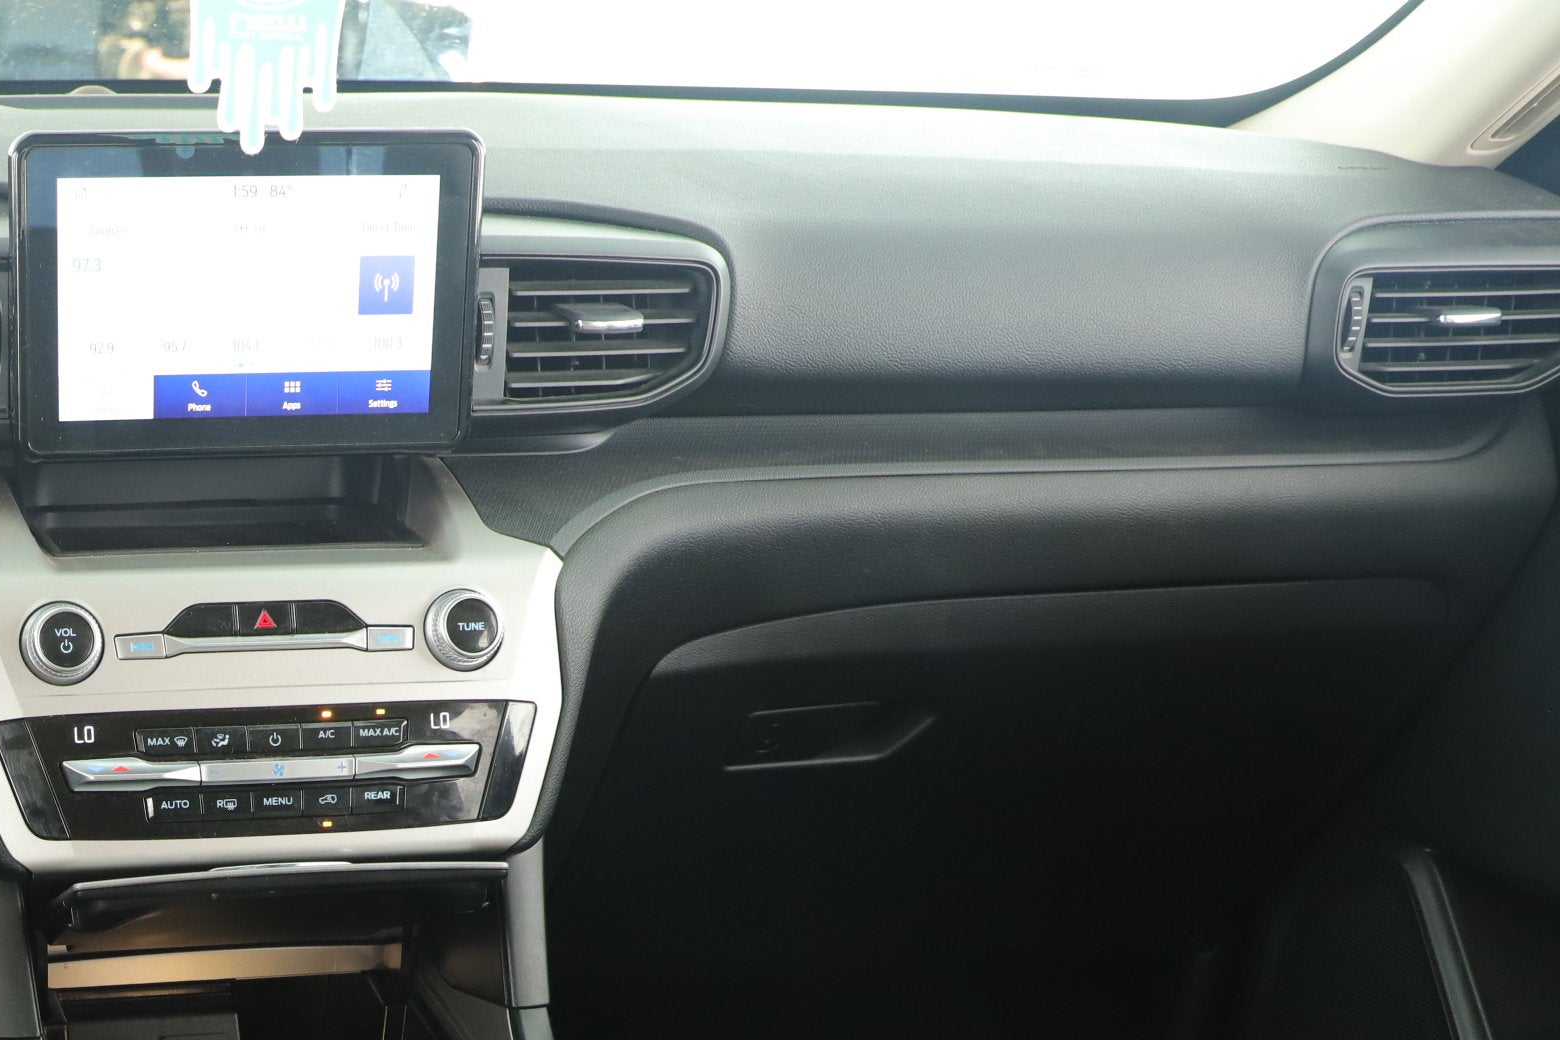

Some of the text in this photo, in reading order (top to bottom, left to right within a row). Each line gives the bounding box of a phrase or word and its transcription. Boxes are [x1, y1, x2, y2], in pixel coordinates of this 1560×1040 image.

[187, 402, 211, 413] Phone
[282, 401, 301, 413] Apps
[368, 398, 398, 411] Settings
[458, 622, 485, 631] TUNE
[54, 628, 77, 637] VOL
[318, 729, 335, 739] A/C
[359, 727, 400, 737] MAX A/C
[147, 737, 171, 746] MAX
[364, 791, 391, 800] REAR
[161, 800, 189, 809] AUTO
[263, 796, 293, 806] MENU
